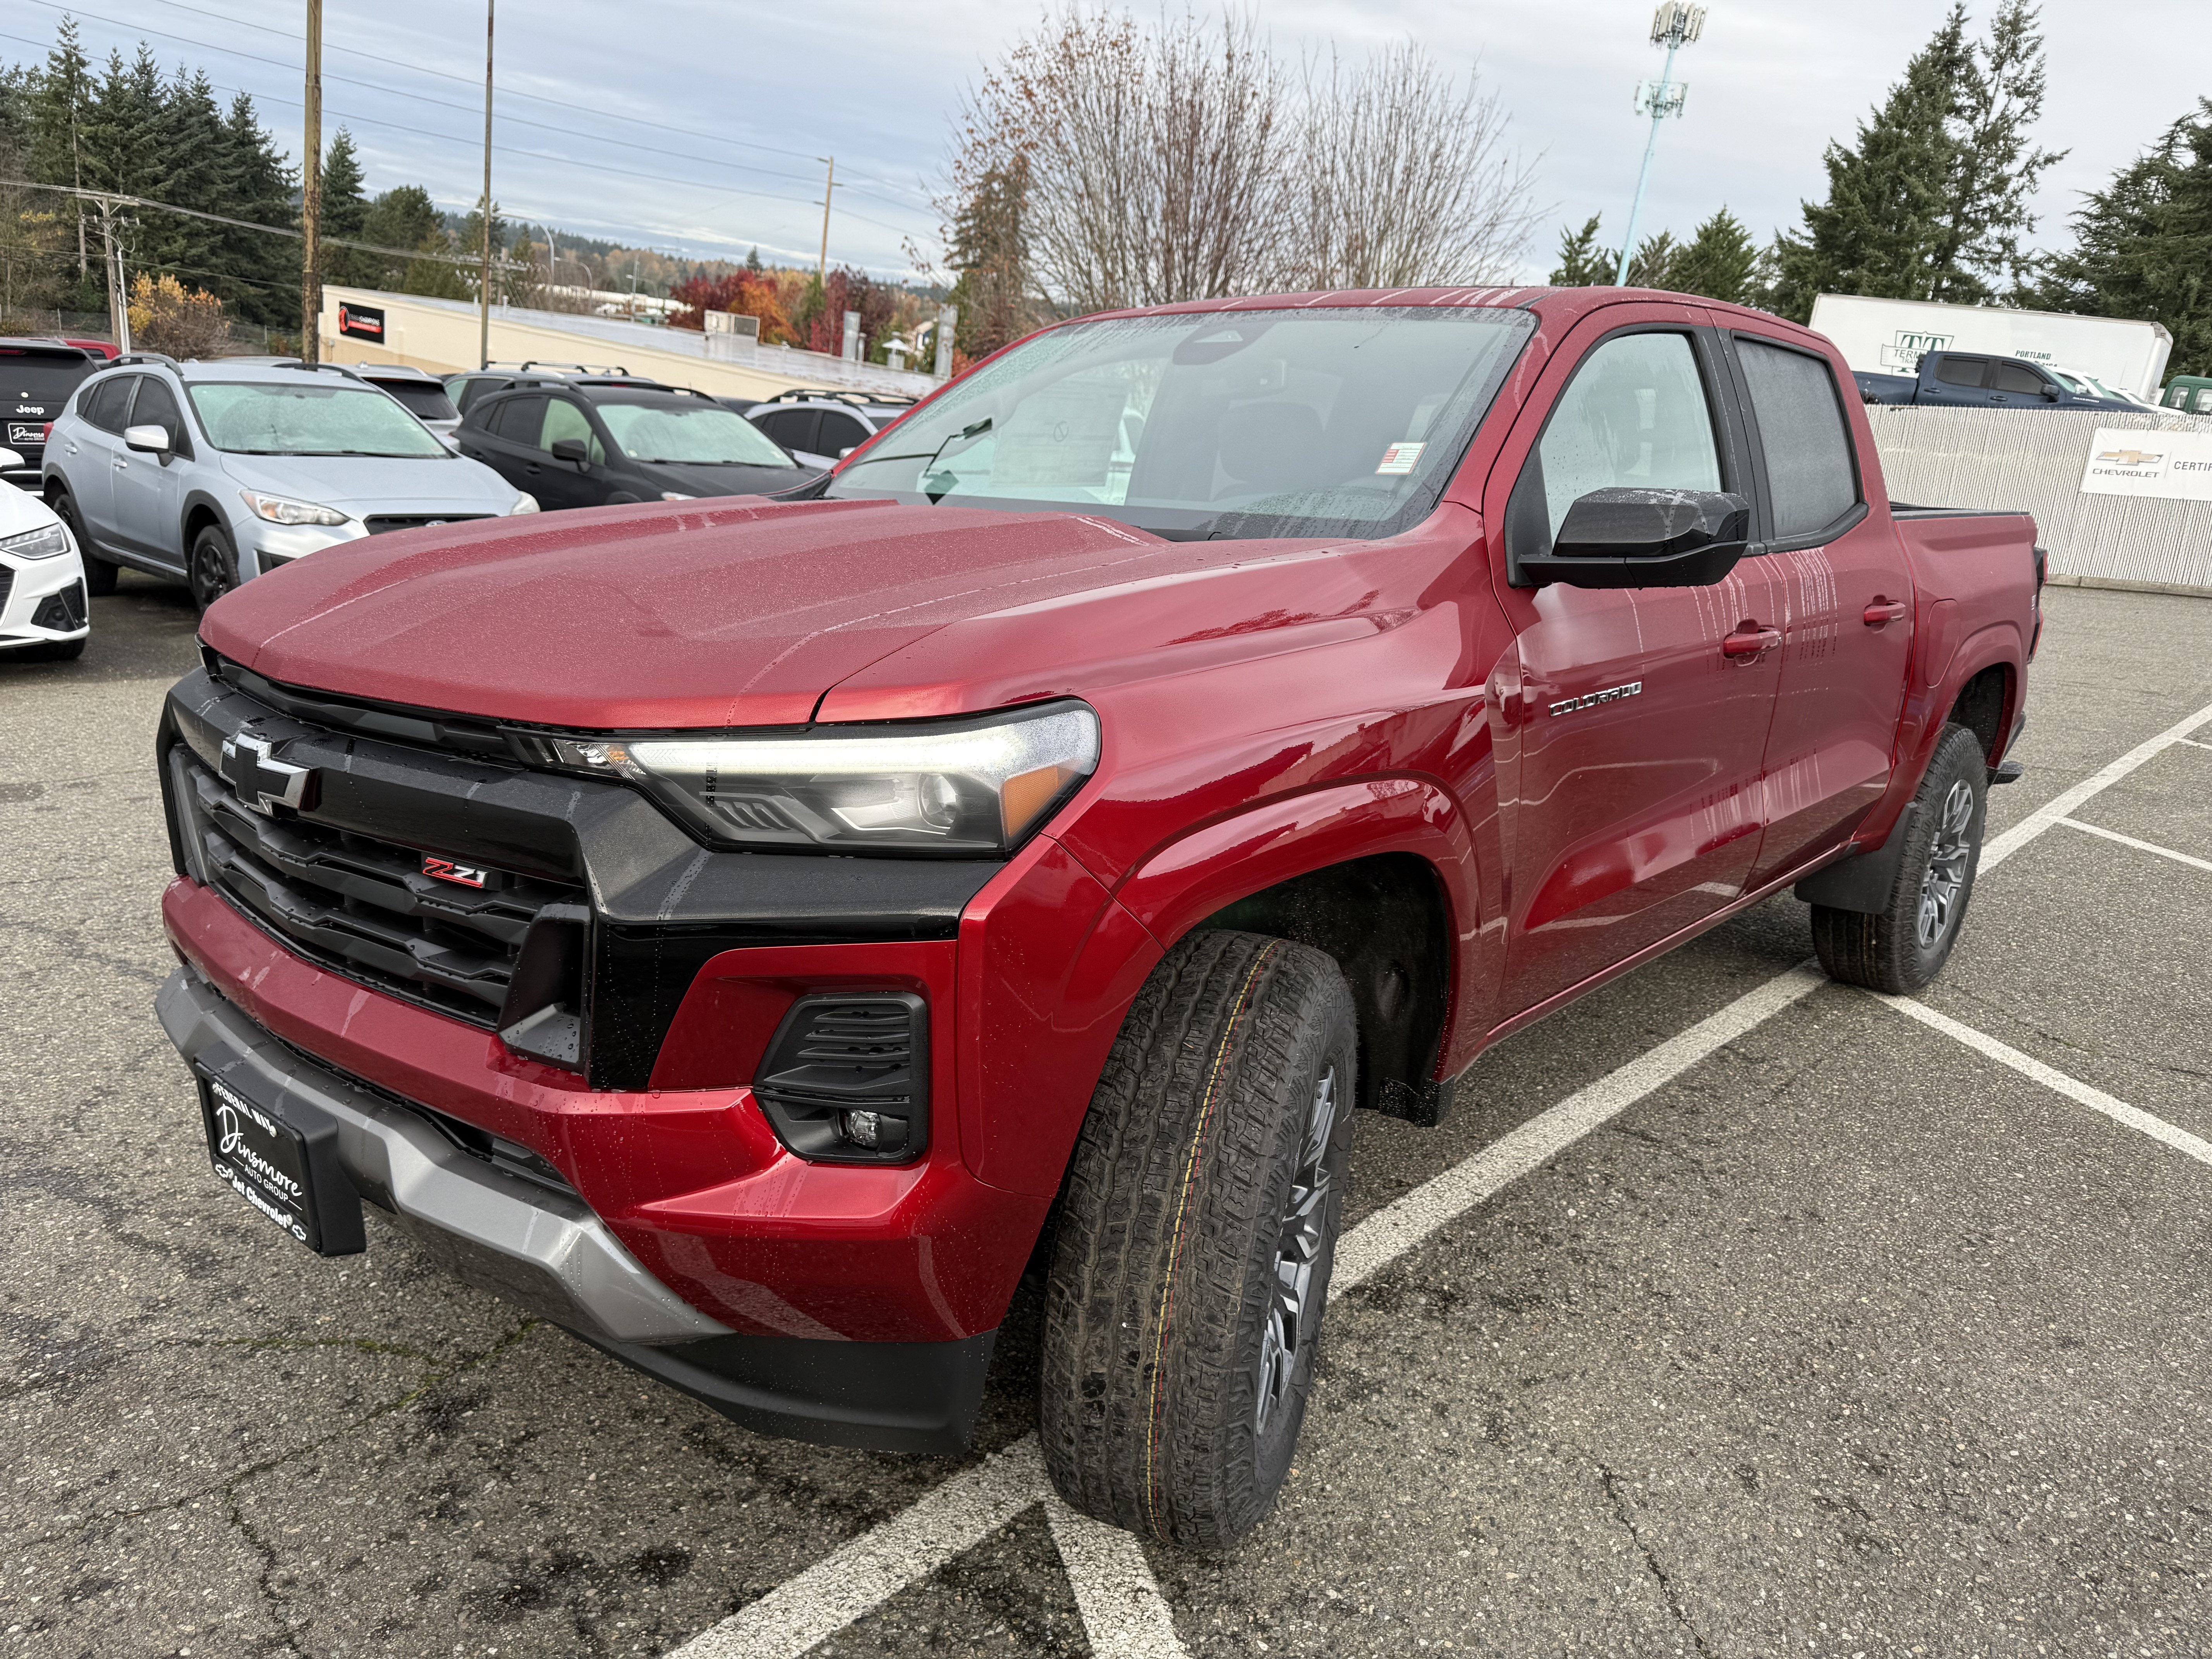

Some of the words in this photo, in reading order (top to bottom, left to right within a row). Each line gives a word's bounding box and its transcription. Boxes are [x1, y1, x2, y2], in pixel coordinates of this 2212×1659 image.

[2015, 350, 2051, 360] PORTLAND
[16, 405, 44, 415] Jeep
[2092, 468, 2160, 478] CHEVROLET
[2174, 461, 2212, 471] CERTIF
[1549, 682, 1642, 716] COLORADO
[422, 857, 487, 888] Z71
[215, 1082, 252, 1119] FEDERAL
[251, 1109, 271, 1133] WAY
[216, 1103, 302, 1197] Dinsmore
[245, 1164, 262, 1183] AUTO
[263, 1179, 288, 1202] GROUP
[232, 1176, 245, 1195] Jet
[247, 1187, 287, 1228] Chevrolet
